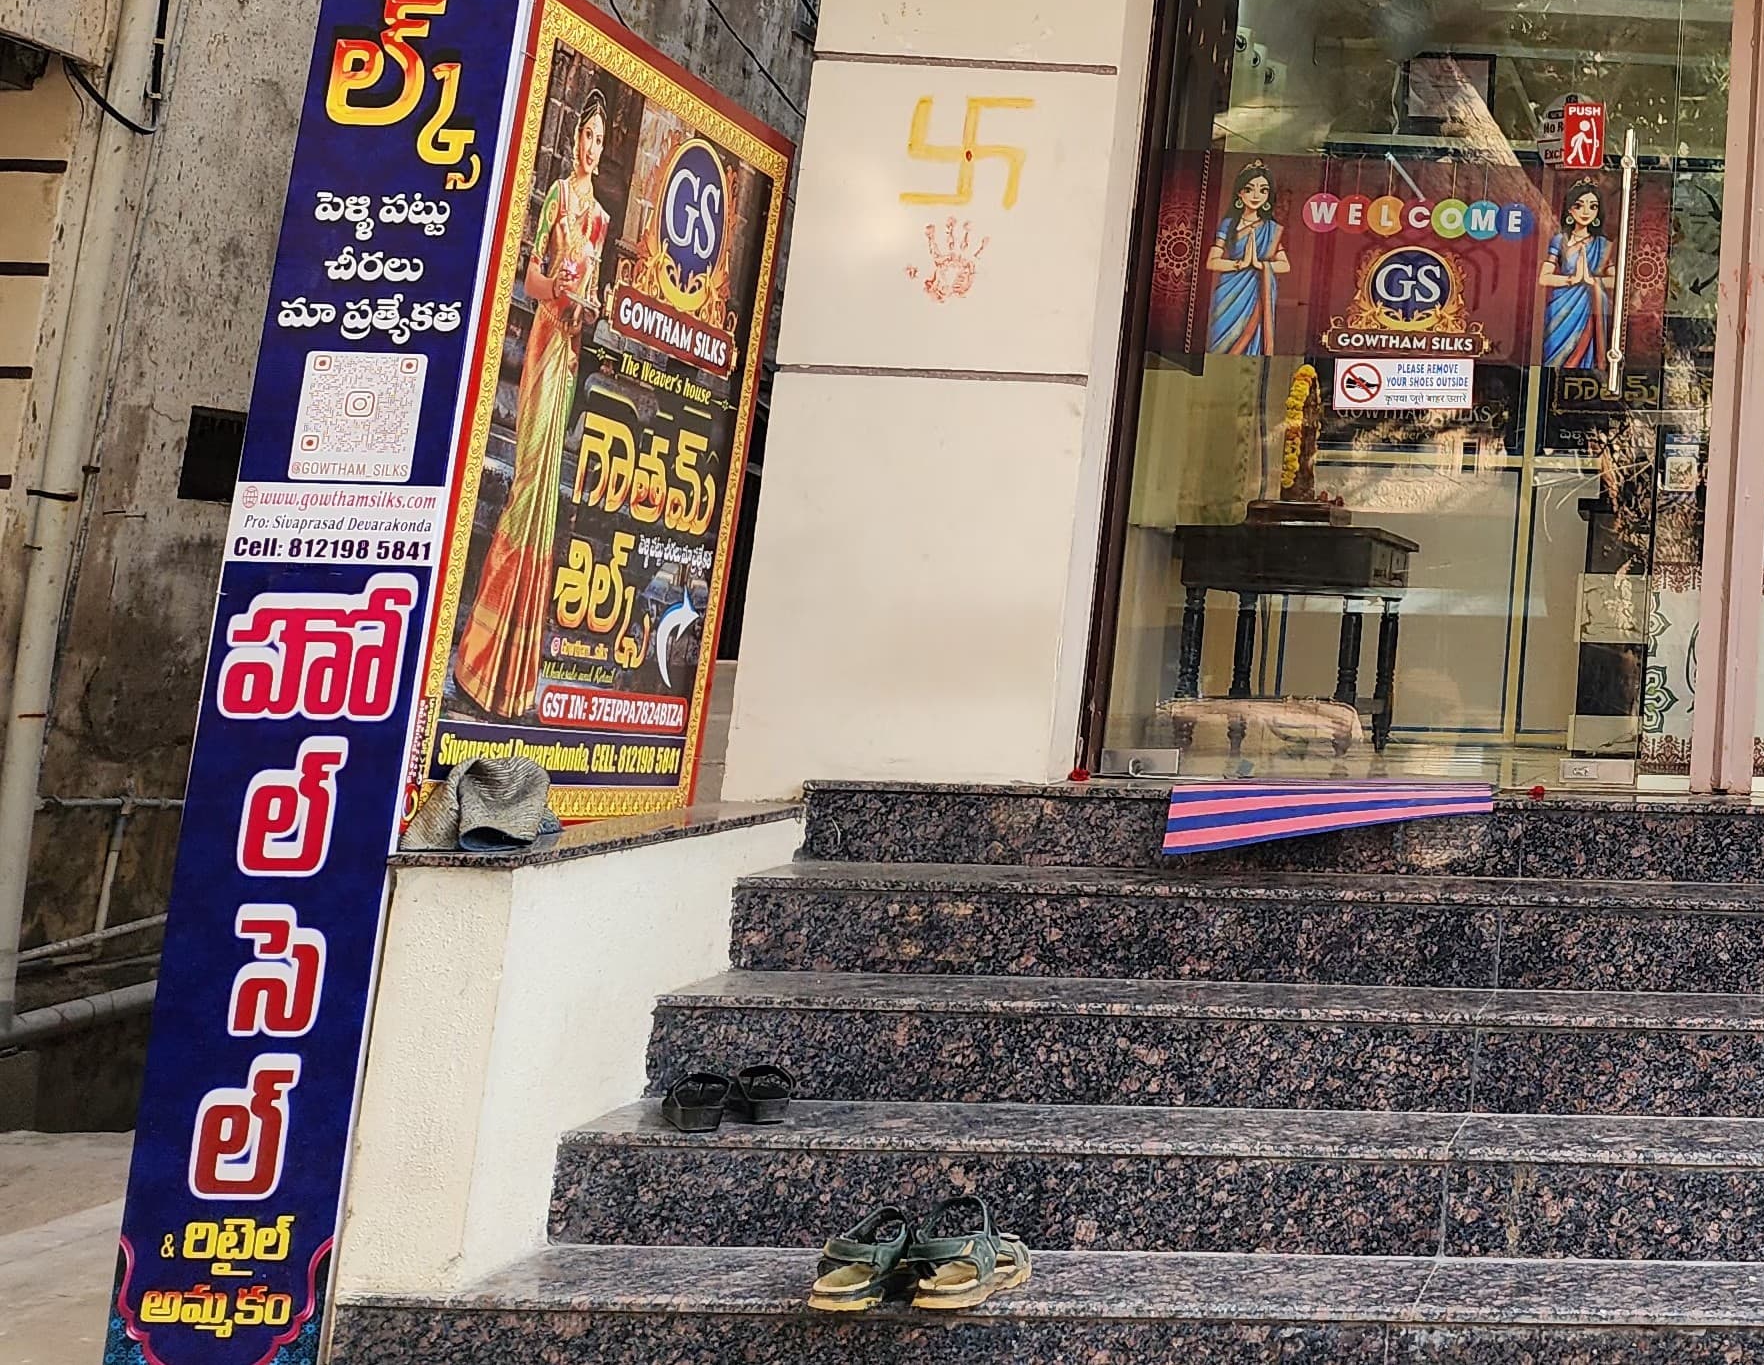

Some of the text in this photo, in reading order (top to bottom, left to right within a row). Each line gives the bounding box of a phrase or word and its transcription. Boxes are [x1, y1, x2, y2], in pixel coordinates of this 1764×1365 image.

[1568, 106, 1601, 116] PUSH
[378, 192, 451, 236] పట్టు
[664, 167, 721, 261] GS
[1309, 200, 1523, 234] WELCOME
[323, 245, 424, 282] చీరలు
[1375, 262, 1442, 304] GS
[277, 292, 462, 345] మా ప్రత్యేకత
[619, 297, 727, 367] GOWTHAM SILKS
[1337, 332, 1474, 352] GOWTHAM SILKS
[620, 352, 712, 405] The Weaver's house
[1386, 376, 1469, 388] YOUR SHOES OUTSIDE
[1397, 363, 1459, 374] PLEASE REMOVE
[291, 461, 408, 478] @GOWTHAM_SILKS
[571, 411, 716, 536] గౌతమ్
[260, 489, 436, 512] www.gowthamsilks.com
[243, 514, 432, 534] Pro: Sivaprasad Devarakonda
[233, 536, 432, 561] Cell: 812198 5841
[541, 691, 569, 719] GST
[567, 694, 588, 720] IN:
[590, 744, 618, 773] CELL:
[617, 745, 655, 774] 812198
[654, 747, 682, 775] 5841
[160, 1214, 296, 1277] & రిటైల్
[140, 1284, 292, 1339] అమ్మకం
